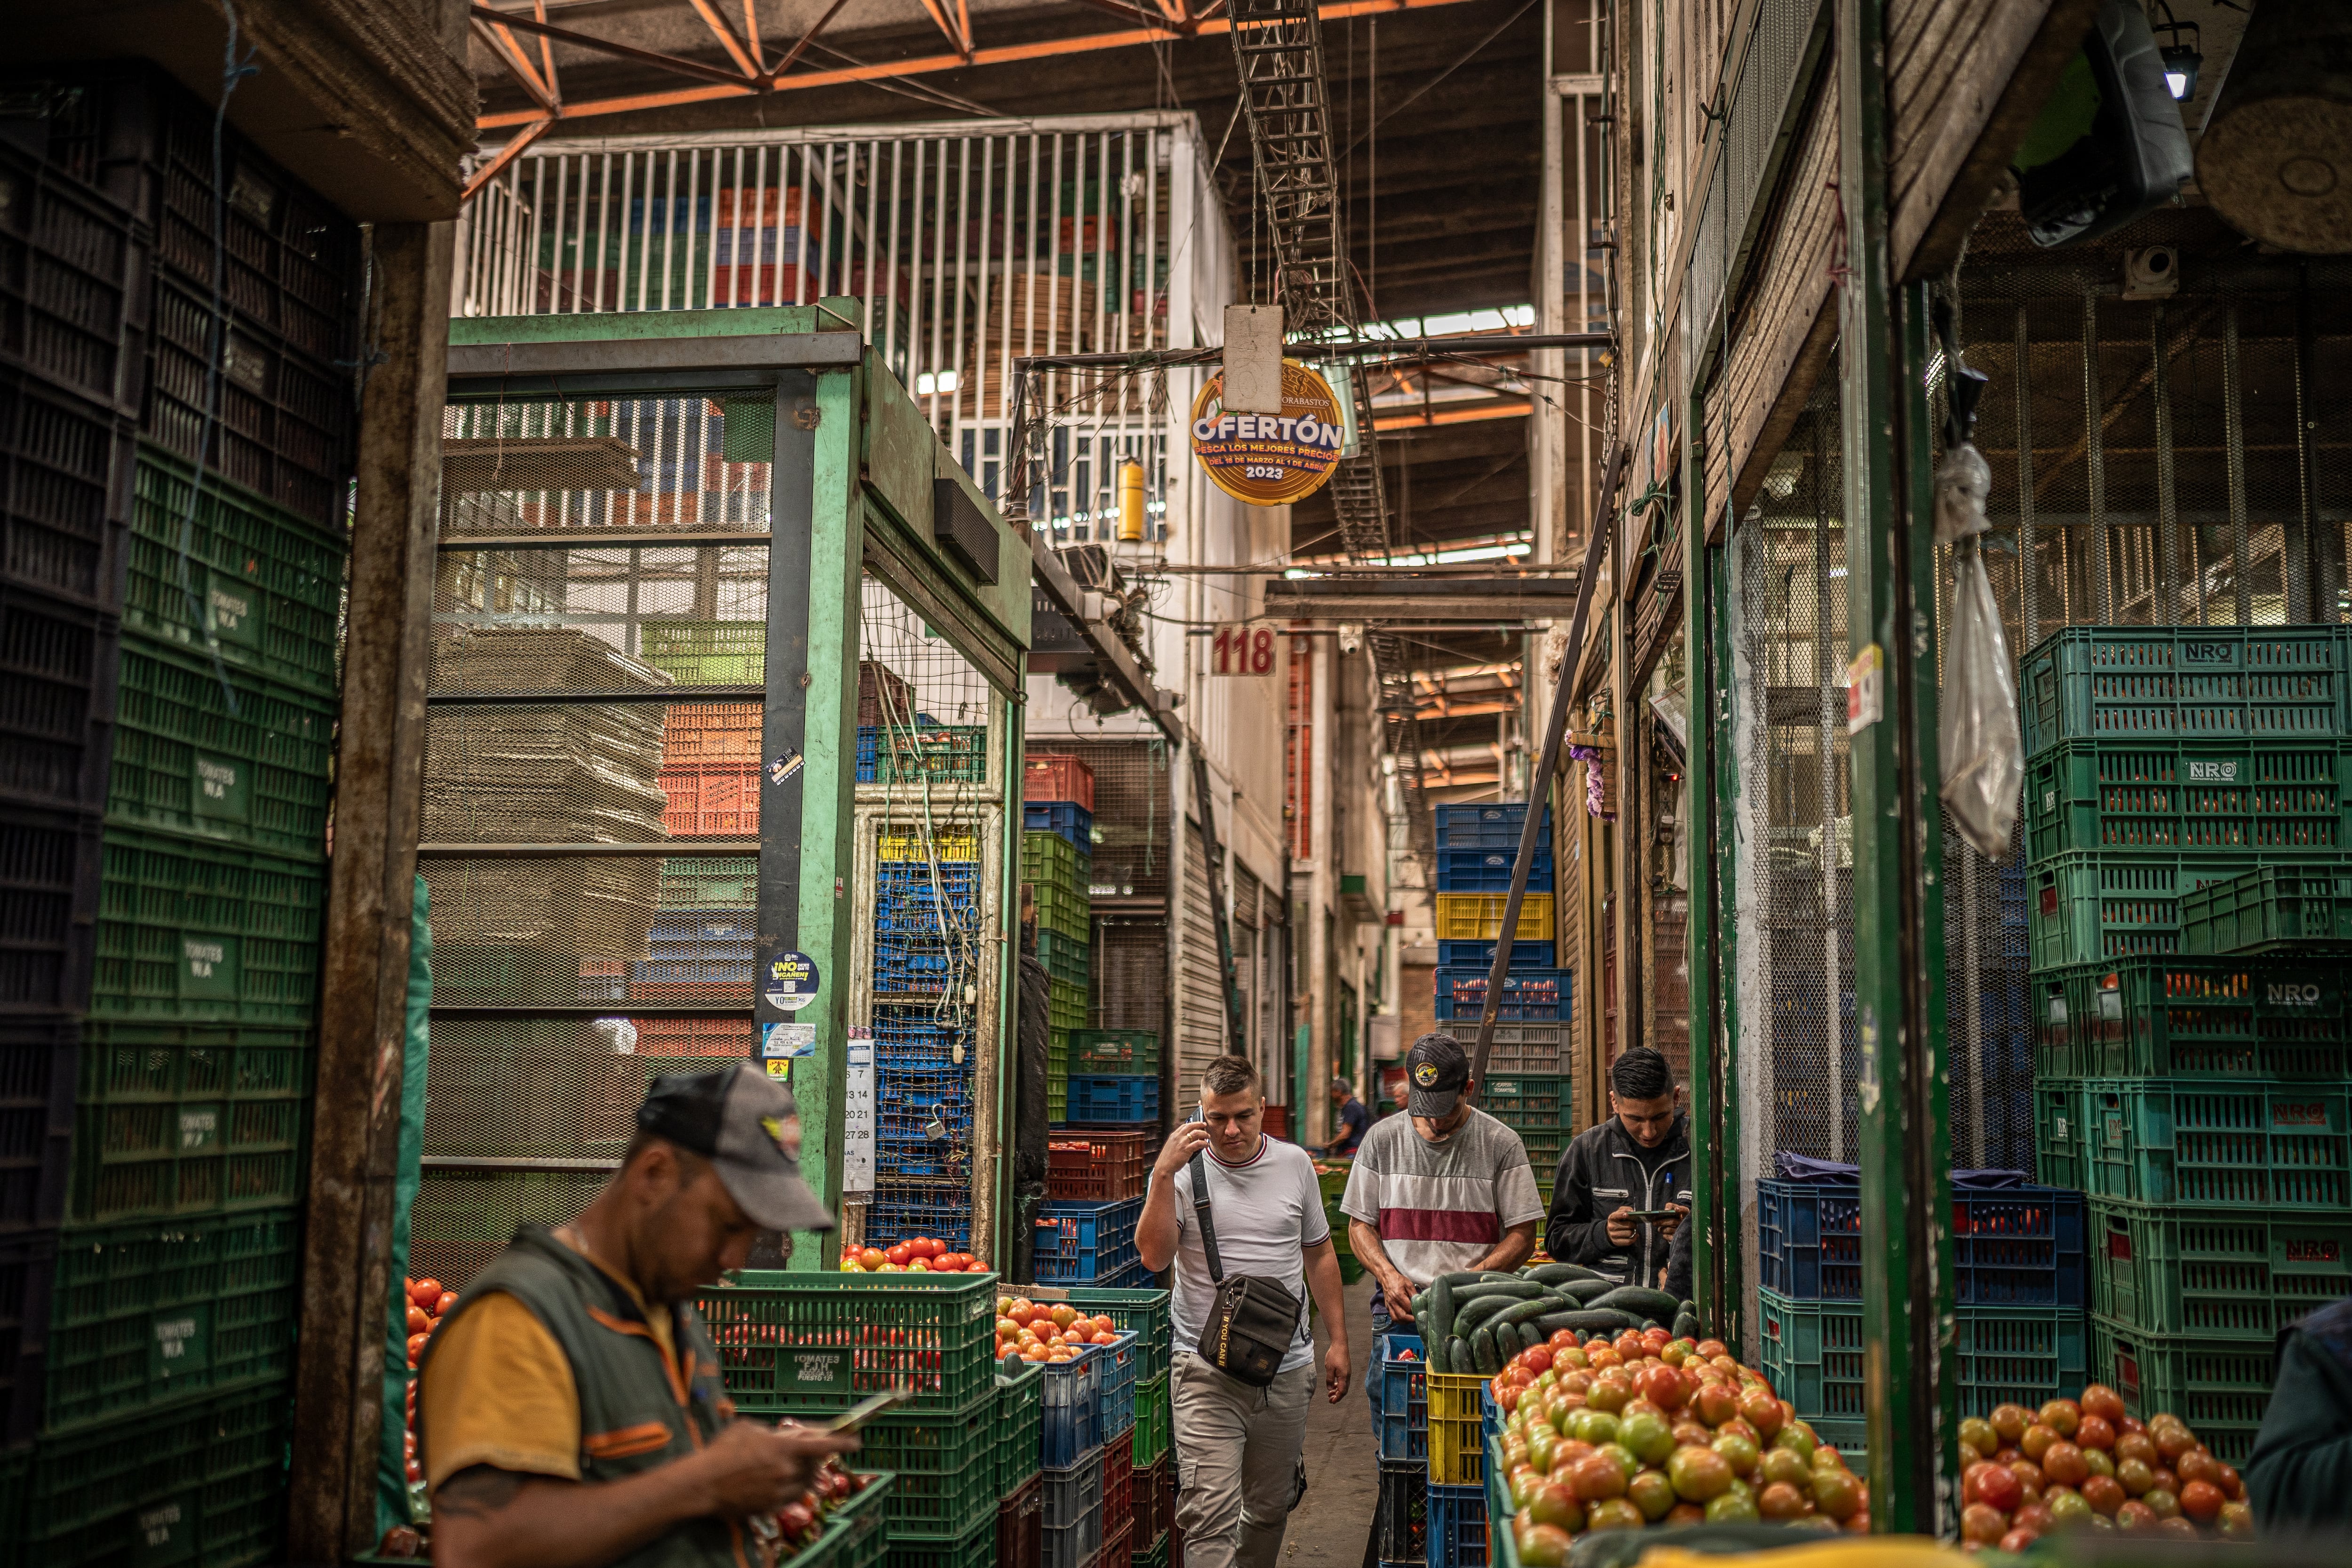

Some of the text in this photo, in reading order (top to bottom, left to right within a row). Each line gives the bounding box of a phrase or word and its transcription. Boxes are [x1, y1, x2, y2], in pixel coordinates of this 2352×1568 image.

[1282, 397, 1330, 406] ORABASTOS
[1192, 414, 1344, 449] OFERTÓN
[1195, 445, 1226, 454] PESCA
[1250, 444, 1295, 454] MEJORES
[1298, 448, 1339, 462] PRECIOS
[1246, 466, 1283, 479] 2023
[1304, 462, 1325, 472] ABRIL
[1214, 628, 1272, 676] 118
[2185, 643, 2232, 659] NRO
[2190, 762, 2237, 777] NRO
[2046, 791, 2055, 808] NR
[2268, 984, 2320, 1002] NRO
[846, 1090, 854, 1099] 13
[2058, 1118, 2067, 1133] NR
